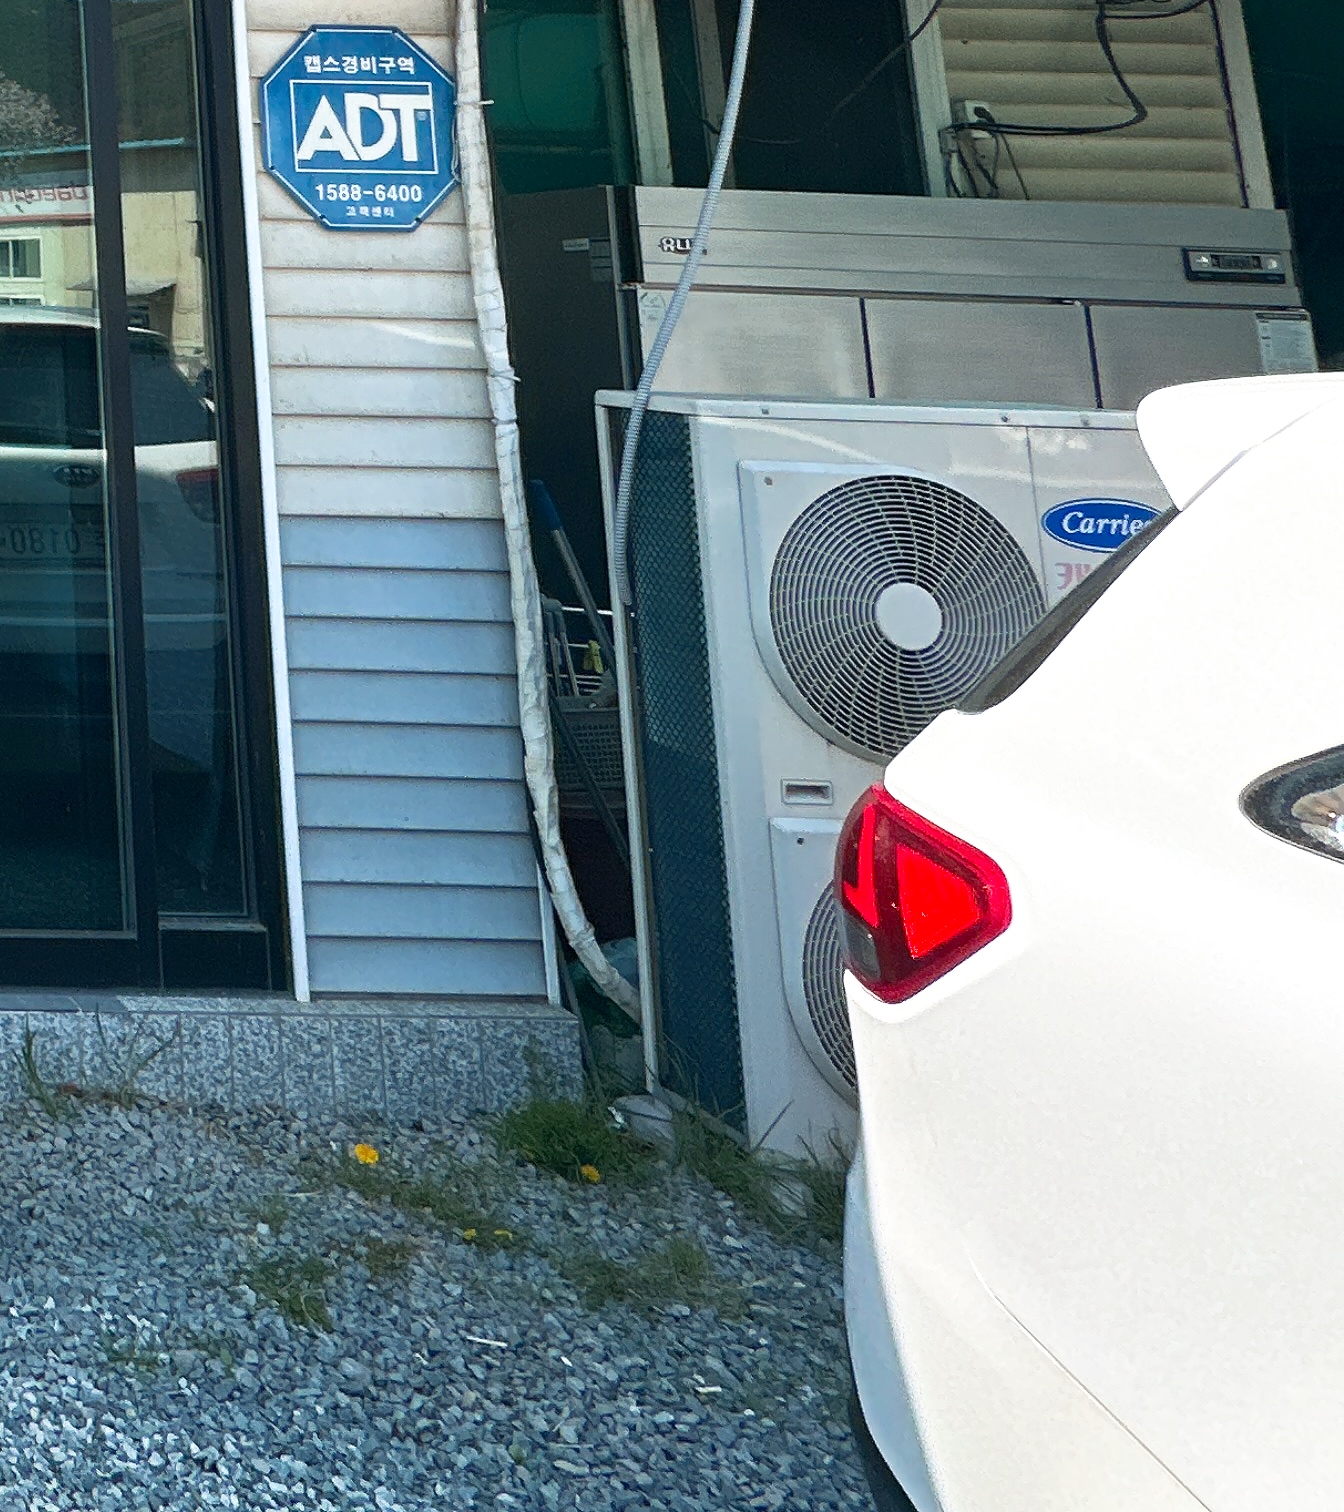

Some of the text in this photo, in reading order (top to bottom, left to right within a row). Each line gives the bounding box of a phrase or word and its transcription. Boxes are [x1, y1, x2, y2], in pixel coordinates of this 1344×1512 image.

[303, 55, 415, 75] 캡스경비구역
[297, 92, 433, 162] ADT
[315, 184, 423, 202] 1588-6400
